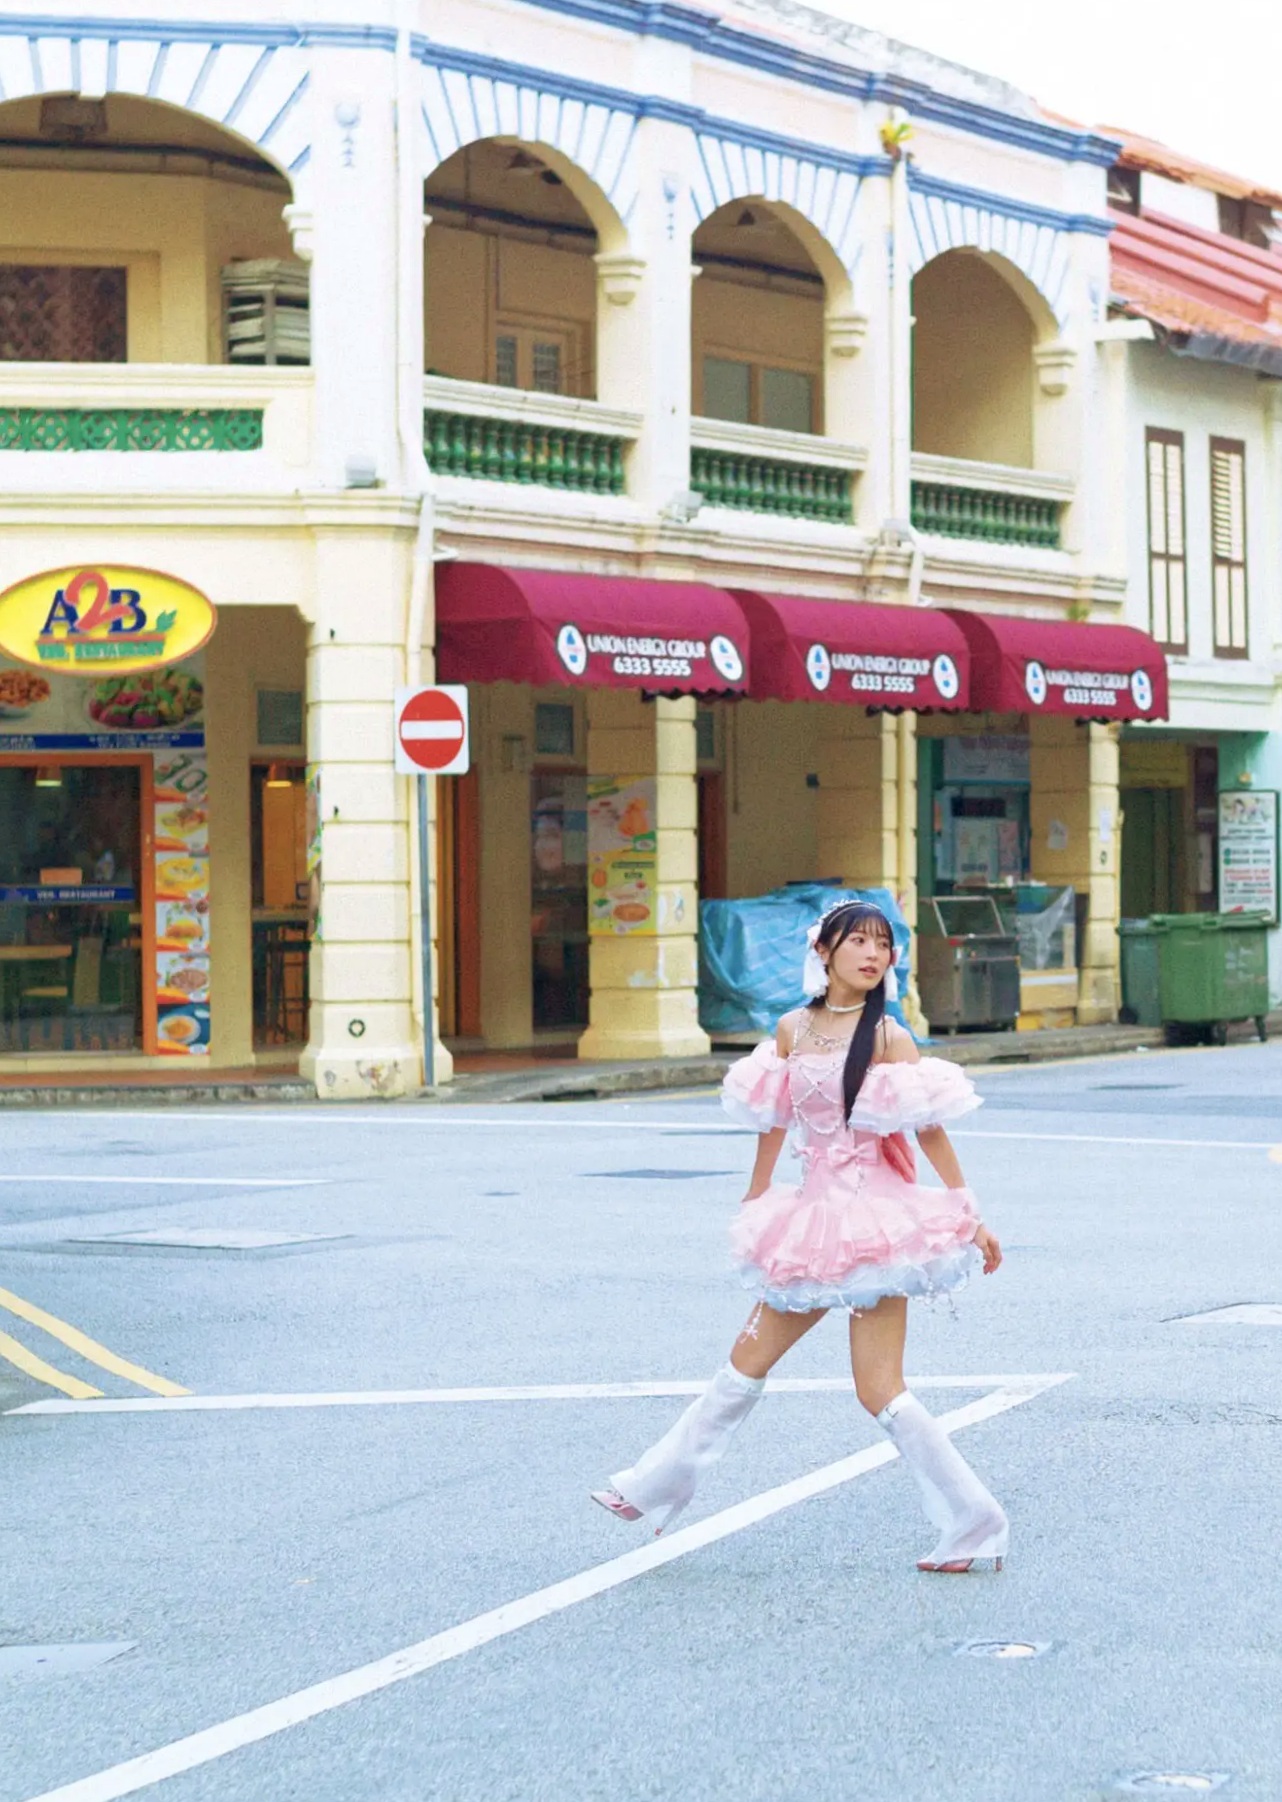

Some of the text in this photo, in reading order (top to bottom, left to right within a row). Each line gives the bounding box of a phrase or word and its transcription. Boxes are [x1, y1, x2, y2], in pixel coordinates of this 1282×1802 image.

[40, 569, 148, 635] A2B
[586, 633, 707, 659] UNION ENERGY GROUP
[613, 656, 692, 676] 6333 5555
[851, 673, 915, 693] 6333 5555
